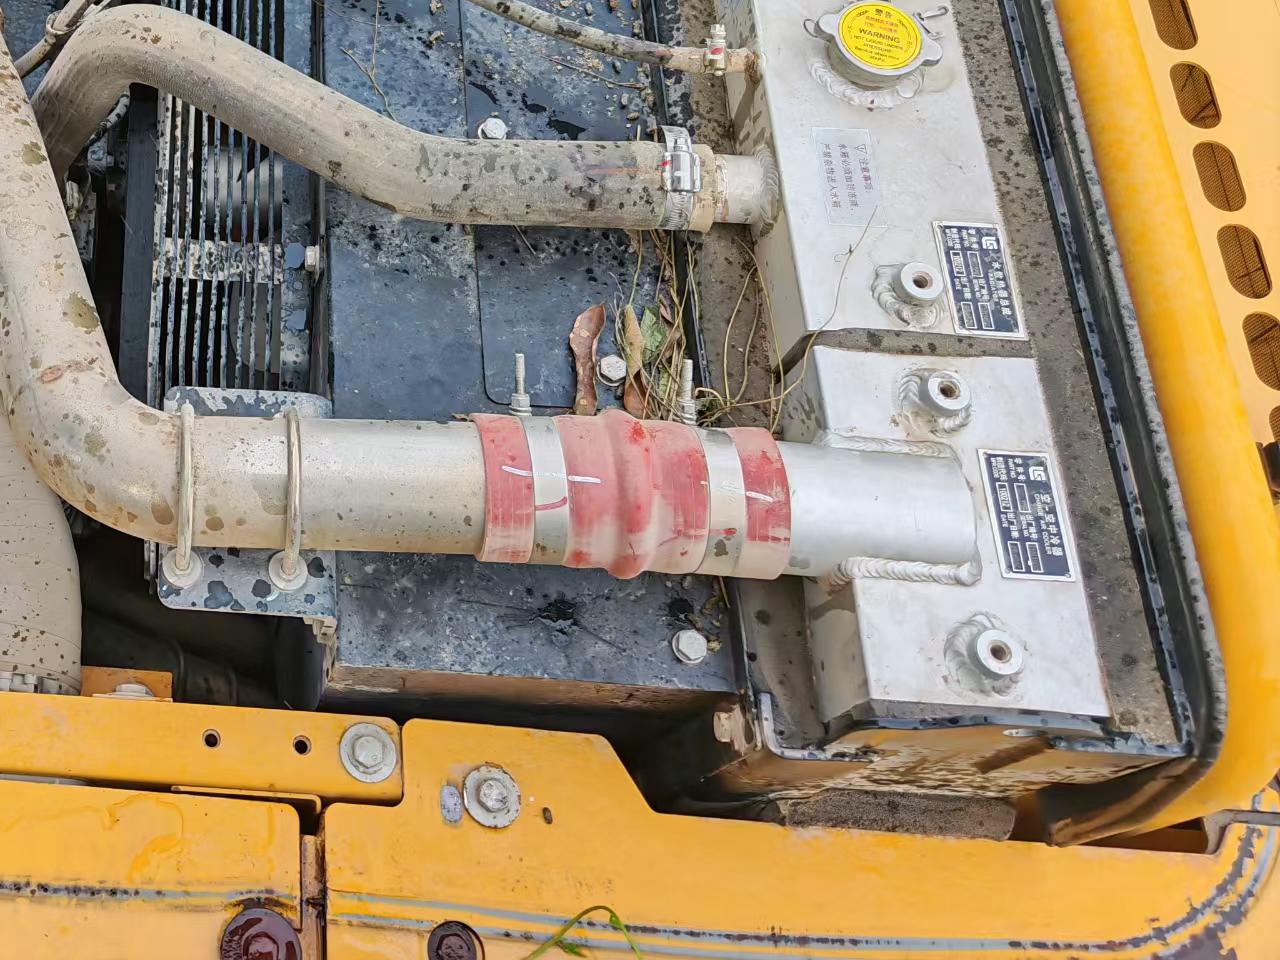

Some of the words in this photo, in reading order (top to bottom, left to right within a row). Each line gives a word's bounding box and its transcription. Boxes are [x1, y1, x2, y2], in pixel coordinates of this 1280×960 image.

[859, 28, 900, 44] WARNING
[1039, 519, 1047, 529] AIR
[1042, 531, 1052, 554] COOLER
